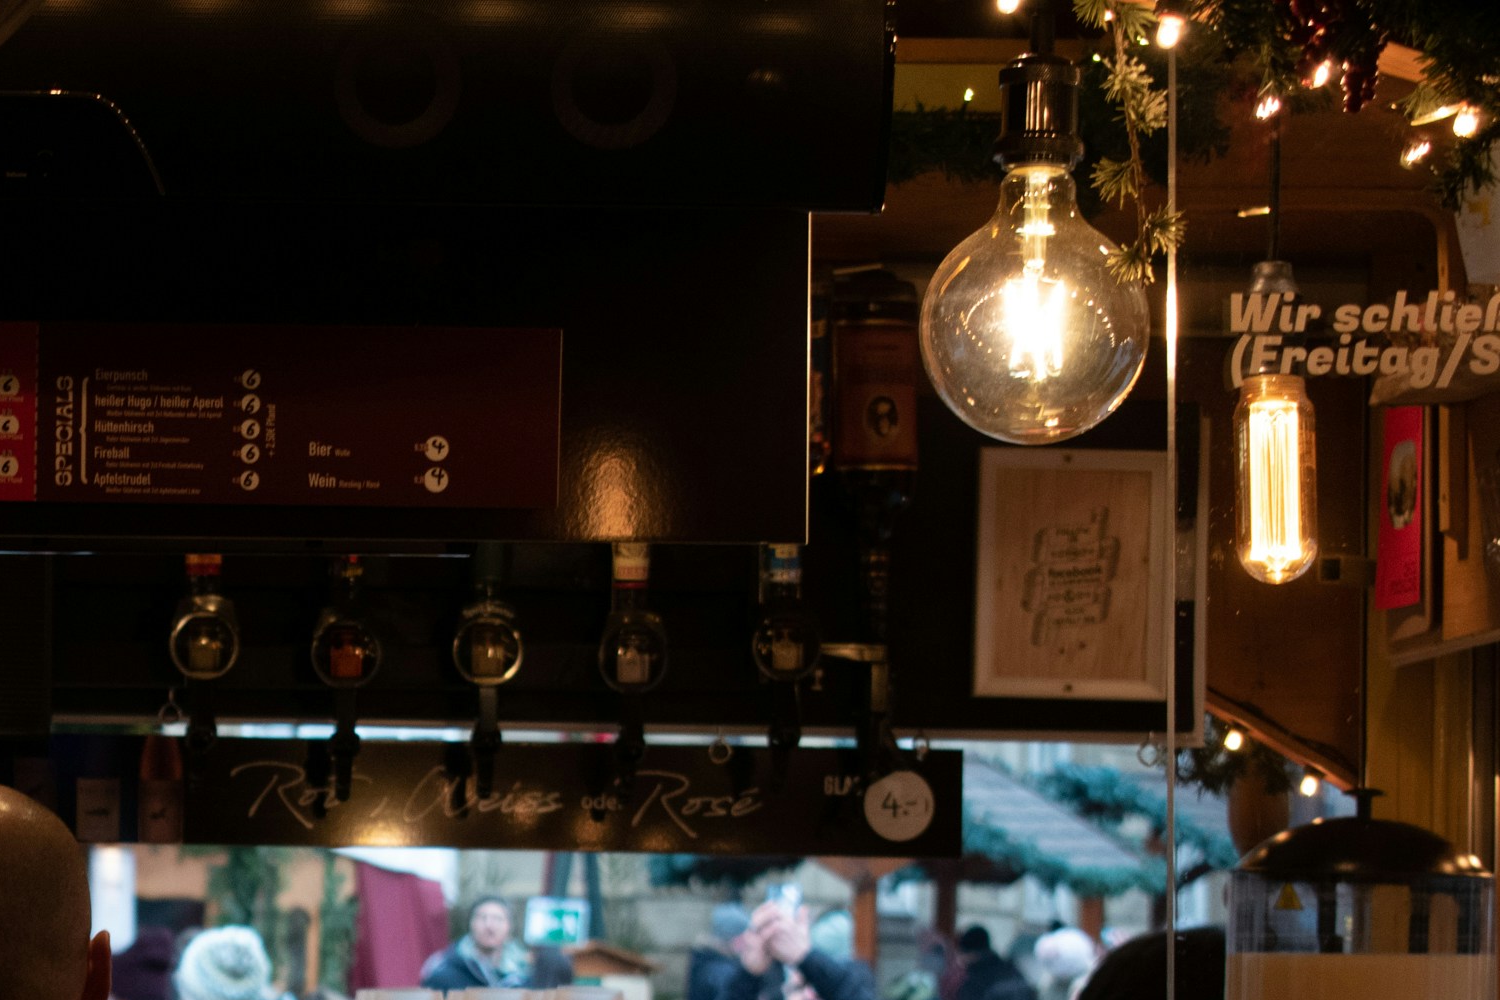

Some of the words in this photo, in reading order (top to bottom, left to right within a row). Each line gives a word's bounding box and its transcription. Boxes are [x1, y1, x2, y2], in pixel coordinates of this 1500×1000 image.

[1230, 291, 1322, 333] Wir
[95, 368, 149, 382] Eierpunsch
[94, 394, 126, 408] heißer
[128, 395, 152, 411] Hugo
[193, 396, 224, 412] Aperol
[55, 375, 73, 487] SPECIALS
[94, 446, 130, 460] Fireball
[308, 440, 333, 457] Bier
[93, 472, 151, 487] Apfelstrudel
[308, 472, 336, 488] Wein
[629, 767, 765, 840] Rosé
